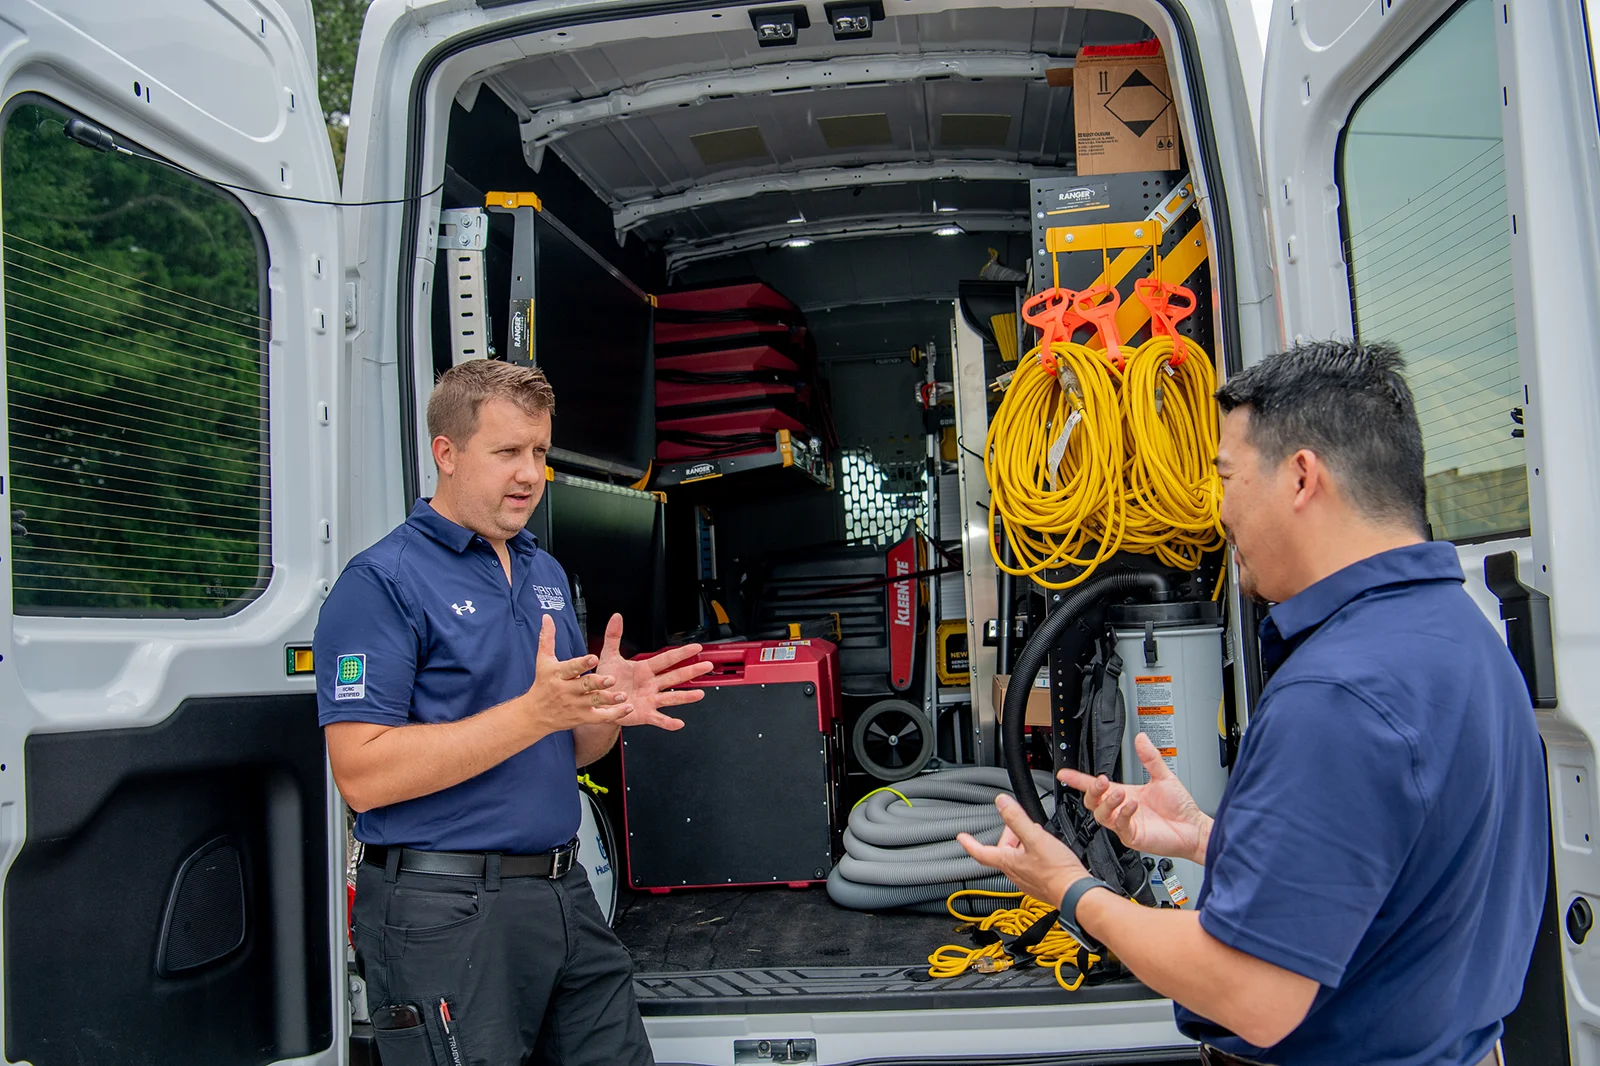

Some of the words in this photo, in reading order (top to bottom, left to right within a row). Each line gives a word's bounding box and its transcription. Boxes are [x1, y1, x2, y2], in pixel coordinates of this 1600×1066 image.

[1058, 190, 1090, 201] RANGER
[685, 465, 710, 475] RANGER
[894, 561, 910, 626] KLEENTE
[950, 651, 968, 659] NEW
